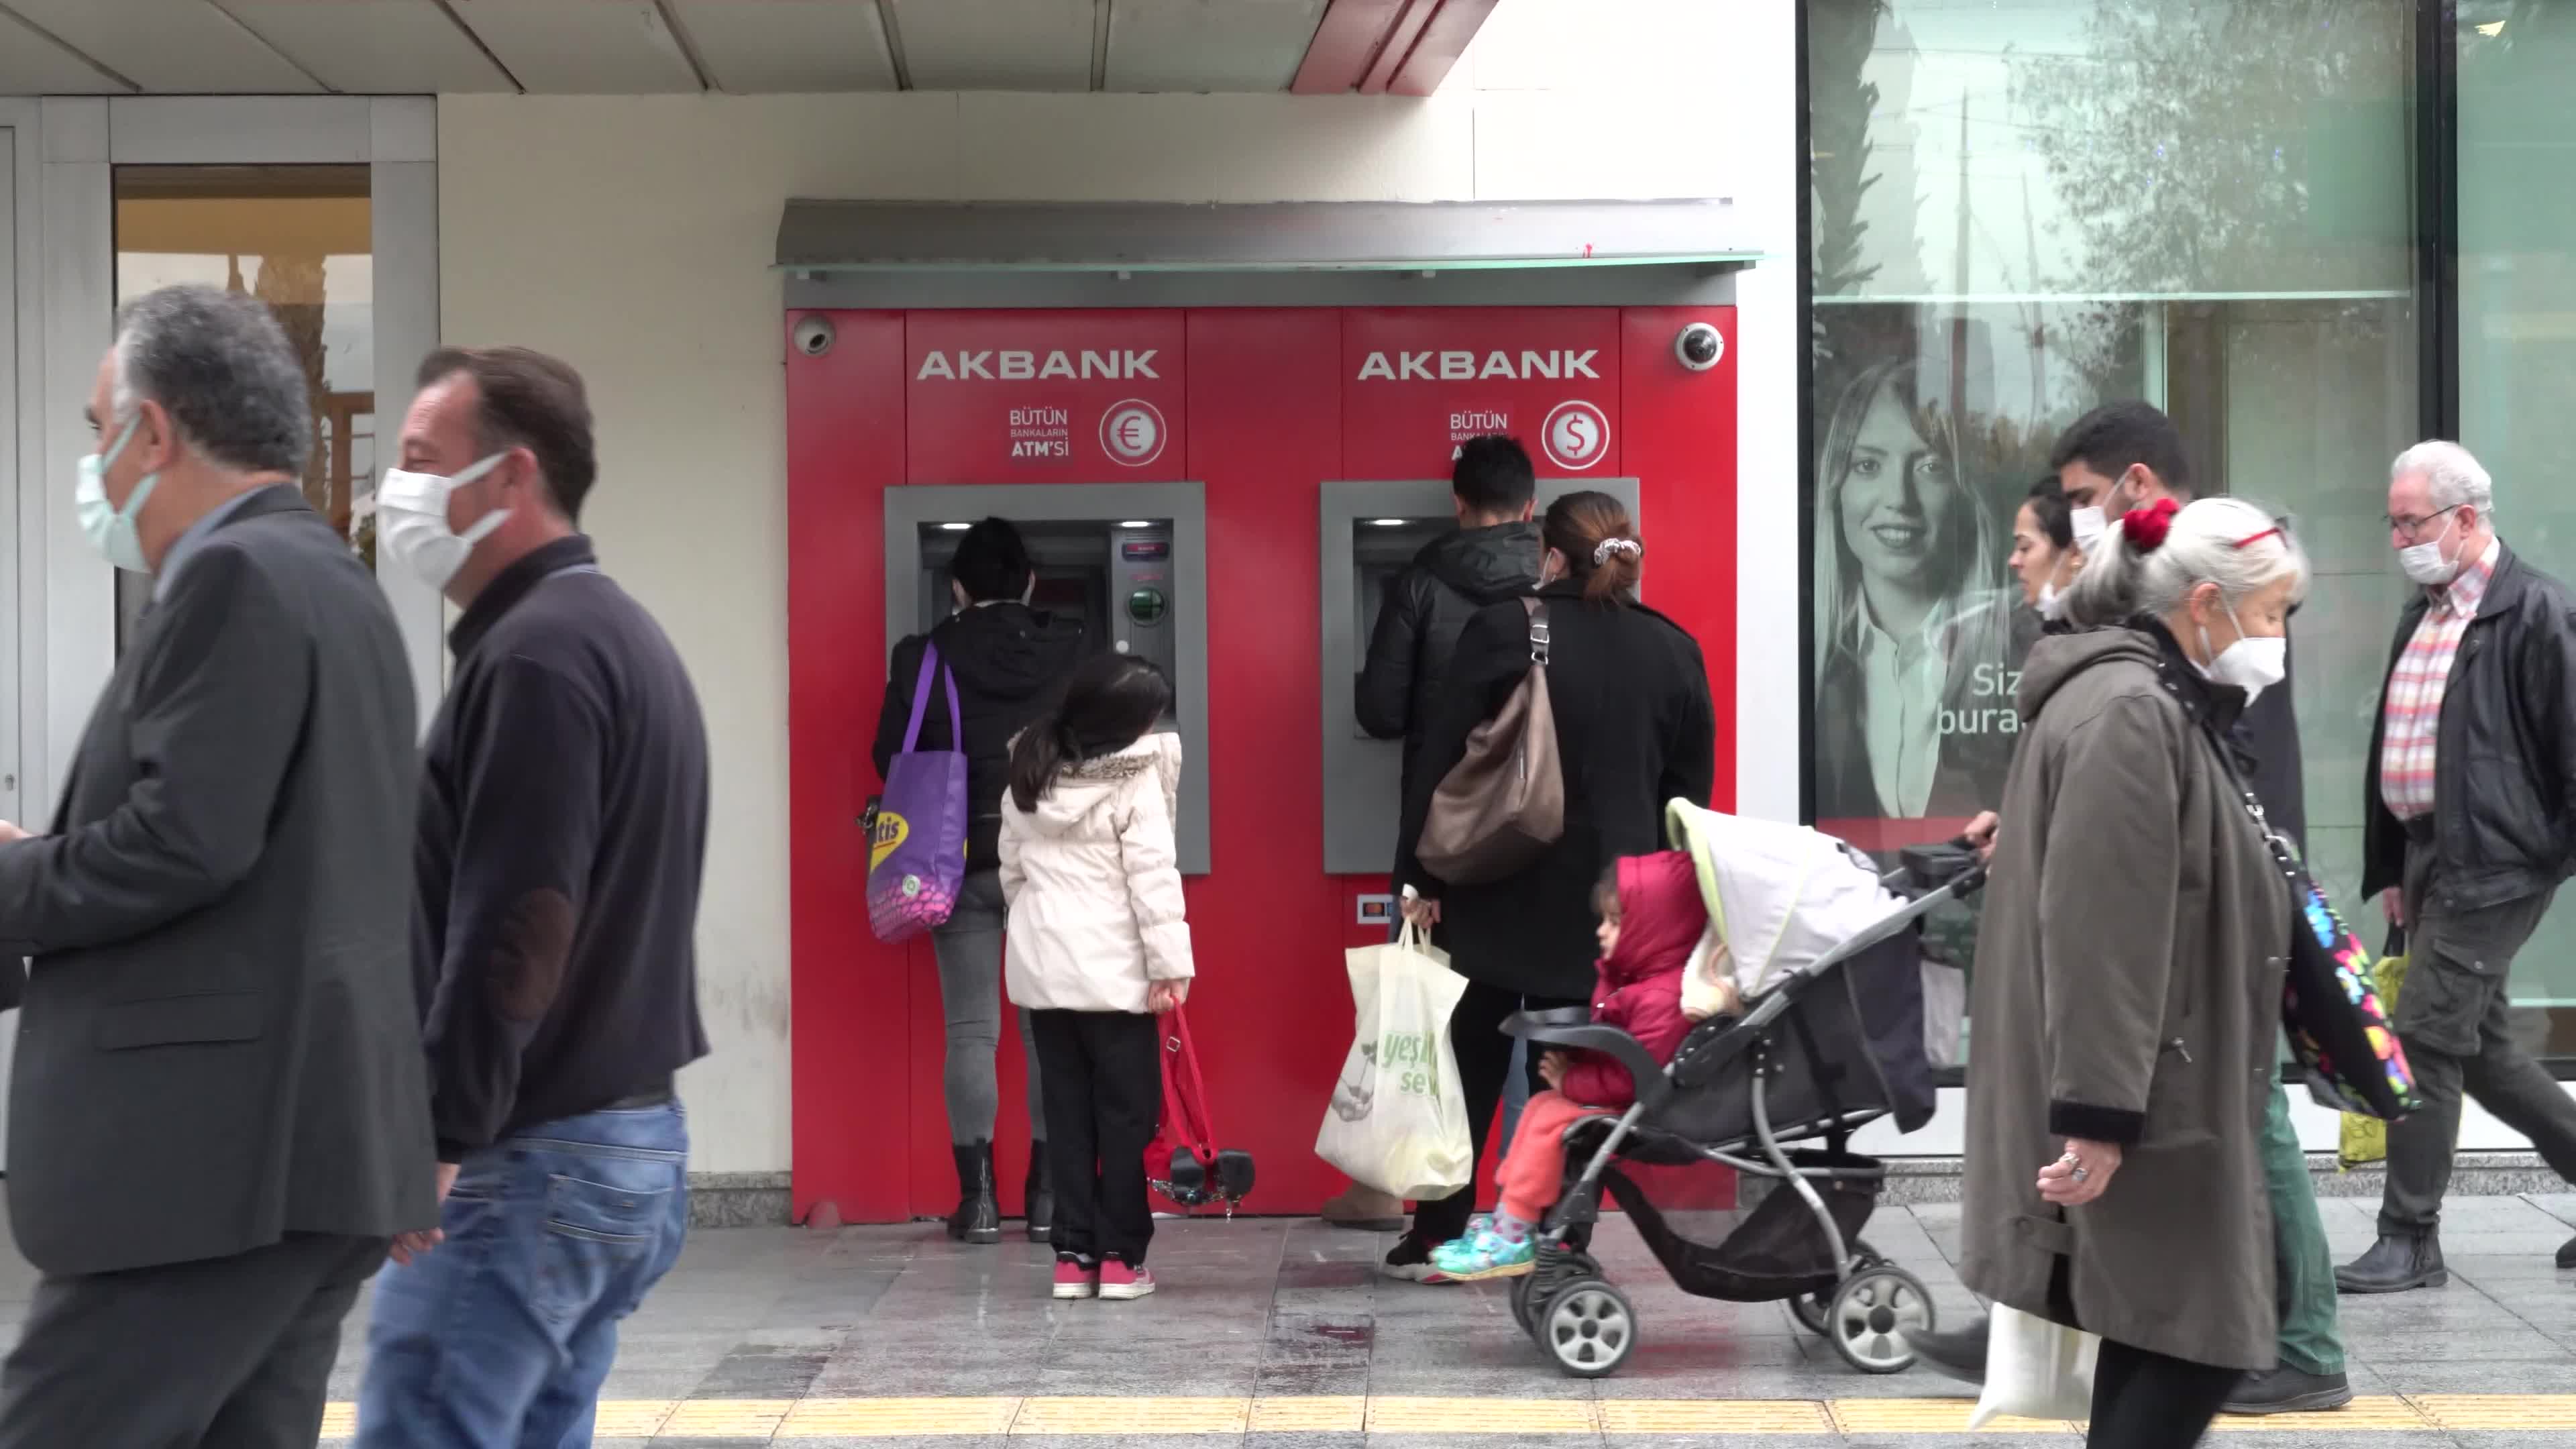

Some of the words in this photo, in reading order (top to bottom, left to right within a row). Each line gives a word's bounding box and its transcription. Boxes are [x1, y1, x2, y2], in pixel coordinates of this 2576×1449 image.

[916, 350, 1161, 380] AKBANK
[1357, 350, 1601, 380] AKBANK
[1010, 406, 1069, 426] BÜTÜN
[1450, 410, 1508, 429] BÜTÜN
[1010, 429, 1069, 438] BANKALARIN
[1012, 437, 1069, 457] ATM'Sİ
[1972, 662, 2023, 696] Siz
[1937, 702, 2027, 735] bura
[875, 815, 900, 842] tis
